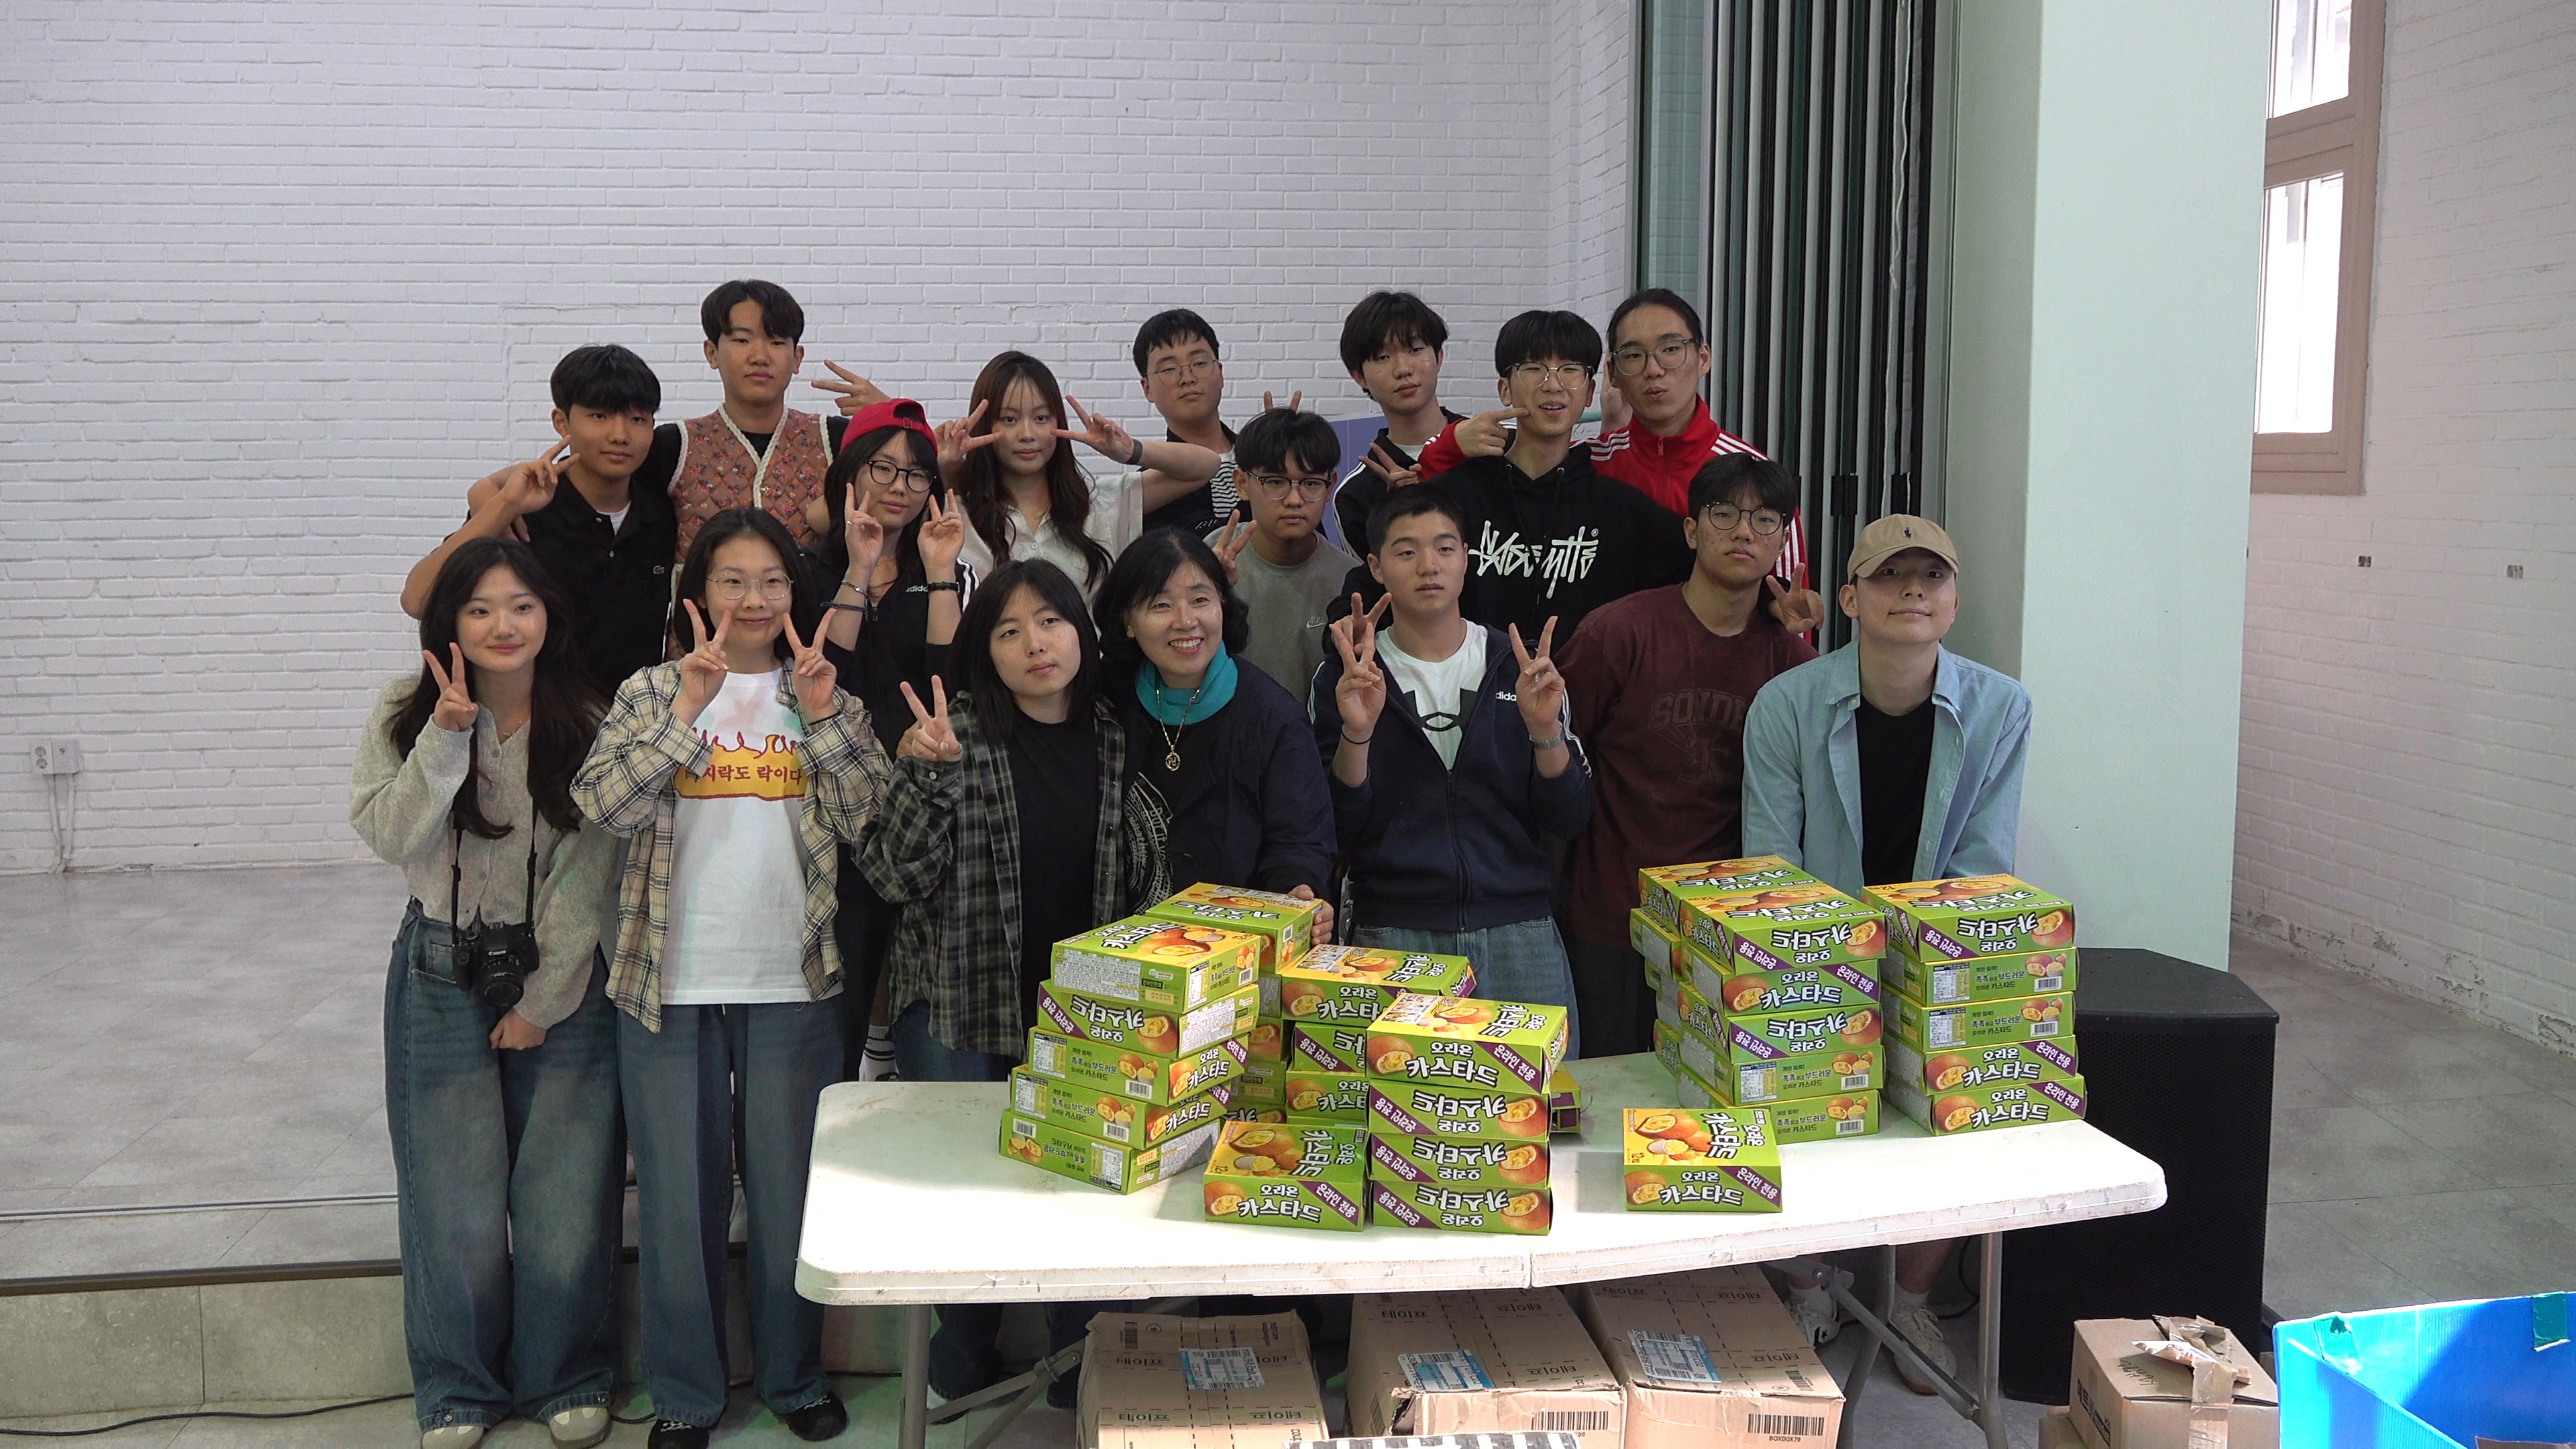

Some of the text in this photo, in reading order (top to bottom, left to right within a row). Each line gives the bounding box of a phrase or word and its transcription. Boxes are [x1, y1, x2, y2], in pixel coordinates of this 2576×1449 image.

[1495, 691, 1516, 702] dida
[757, 765, 802, 785] 락이다
[1676, 869, 1794, 888] 카스타드
[1726, 899, 1852, 918] 카스타드
[1911, 890, 2037, 908] 카스타드
[1171, 900, 1280, 920] 카스타드
[1101, 922, 1185, 949] 카스타드
[1957, 912, 2039, 939] 카스타드
[1692, 927, 1720, 959] 카스타드
[1772, 922, 1853, 951] 카스타드
[1925, 930, 1963, 959] 온라인 전용
[1980, 938, 2017, 953] 오리온
[1739, 941, 1778, 971] 온라인 전용
[1794, 949, 1831, 964] 오리온
[1382, 954, 1433, 983] 카스타드
[1781, 971, 1819, 984] 오리온
[1998, 969, 2025, 980] 부드러운
[1836, 965, 1874, 993] 온라인 전용
[1991, 981, 2016, 989] 카스타드
[1339, 986, 1378, 1000] 오리온
[1760, 983, 1843, 1010] 카스타드
[1042, 996, 1056, 1014] 전용
[1070, 994, 1145, 1030] 카스타드
[1317, 1000, 1387, 1021] 카스타
[1054, 1010, 1075, 1034] 온라인
[1479, 1004, 1529, 1038] 카스타드
[1523, 1014, 1547, 1030] 오리온
[1767, 1012, 1847, 1040] 카스타드
[1987, 1026, 2012, 1034] 카스타드
[1994, 1015, 2021, 1026] 부드러운
[1089, 1025, 1124, 1042] 오리온
[1299, 1038, 1316, 1055] 전용
[1430, 1041, 1474, 1057] 오리온
[1735, 1030, 1772, 1059] 온라인 전용
[1789, 1038, 1826, 1053] 오리온
[1199, 1048, 1219, 1064] 오리온
[1237, 1047, 1247, 1063] 전용
[1314, 1049, 1338, 1070] 온라인
[1493, 1044, 1536, 1081] 온라인 전용
[1983, 1048, 2019, 1062] 오리온
[2035, 1042, 2072, 1069] 온라인 전용
[1187, 1061, 1230, 1091] 카스타드
[1405, 1057, 1501, 1087] 카스타드
[1805, 1069, 1831, 1080] 부드러운
[1962, 1061, 2041, 1087] 카스타드
[1338, 1081, 1371, 1092] 오리온
[1798, 1080, 1823, 1088] 카스타드
[1411, 1089, 1507, 1118] 카스타드
[1990, 1088, 2027, 1104] 오리온
[2043, 1083, 2080, 1109] 온라인 전용
[1166, 1102, 1210, 1132] 카스타드
[1375, 1097, 1417, 1133] 온라인 전용
[1799, 1114, 1827, 1124] 부드러운
[1970, 1102, 2049, 1128] 카스타드
[1437, 1119, 1481, 1133] 오리온
[1701, 1112, 1743, 1159] 카스타드
[1743, 1124, 1765, 1147] 오리온
[1792, 1124, 1818, 1132] 카스타드
[1289, 1130, 1334, 1177] 카스타드
[1336, 1143, 1356, 1165] 오리온
[1411, 1137, 1507, 1165] 카스타드
[1375, 1145, 1417, 1181] 온라인 전용
[1437, 1167, 1481, 1180] 오리온
[1681, 1171, 1720, 1183] 오리온
[1737, 1167, 1778, 1199] 온라인 전용
[1260, 1184, 1299, 1197] 오리온
[1316, 1183, 1356, 1218] 온라인 전용
[1415, 1183, 1510, 1212] 카스타드
[1659, 1185, 1744, 1206] 카스타드
[1238, 1198, 1322, 1223] 카스타드
[1379, 1191, 1421, 1226] 온라인 전용
[1440, 1213, 1484, 1226] 오리온
[1382, 1310, 1428, 1319] 테이프
[1116, 1357, 1164, 1366] 테이프
[1256, 1355, 1287, 1364] 테이
[1119, 1413, 1170, 1421] 테이프
